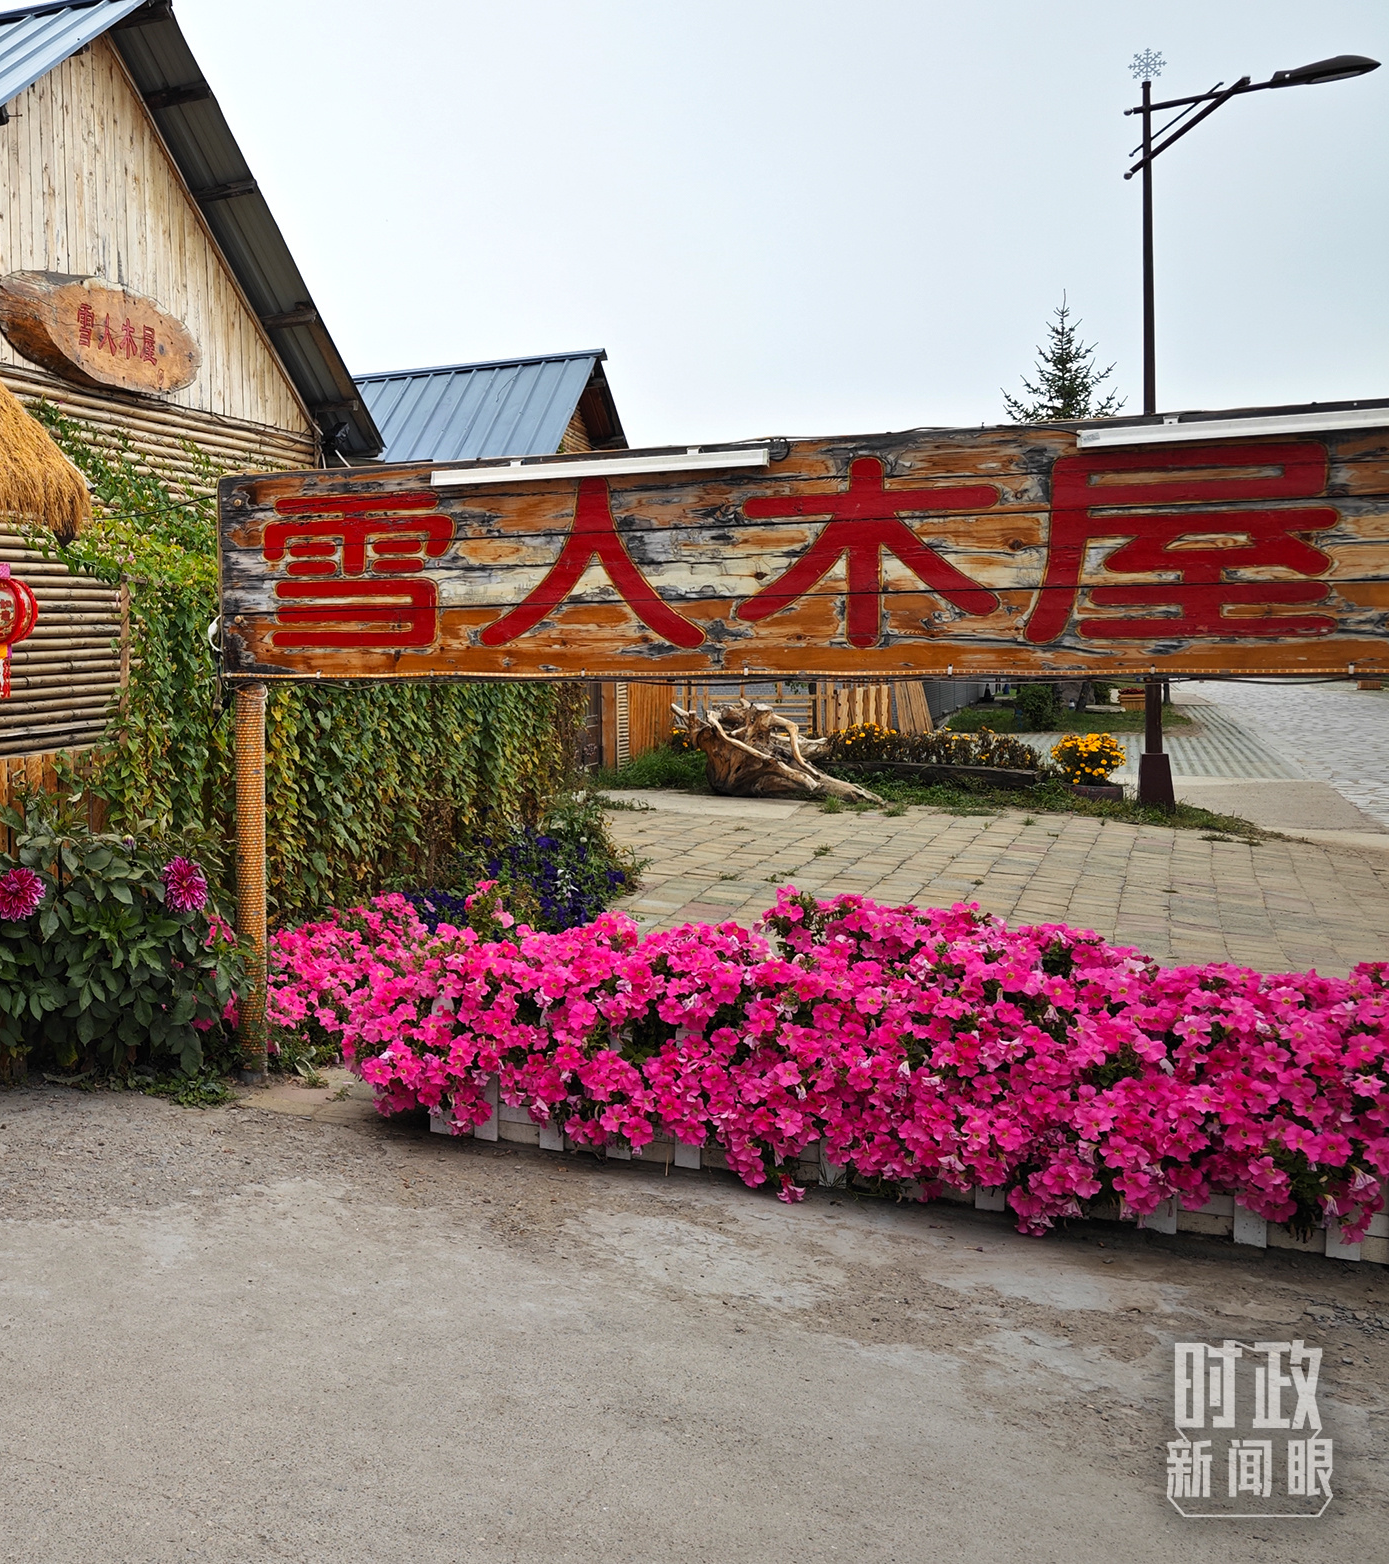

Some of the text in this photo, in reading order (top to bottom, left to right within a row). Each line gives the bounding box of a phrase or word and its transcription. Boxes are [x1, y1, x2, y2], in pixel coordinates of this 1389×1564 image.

[77, 303, 158, 366] 雪人木屋
[262, 440, 1341, 649] 雪人木屋
